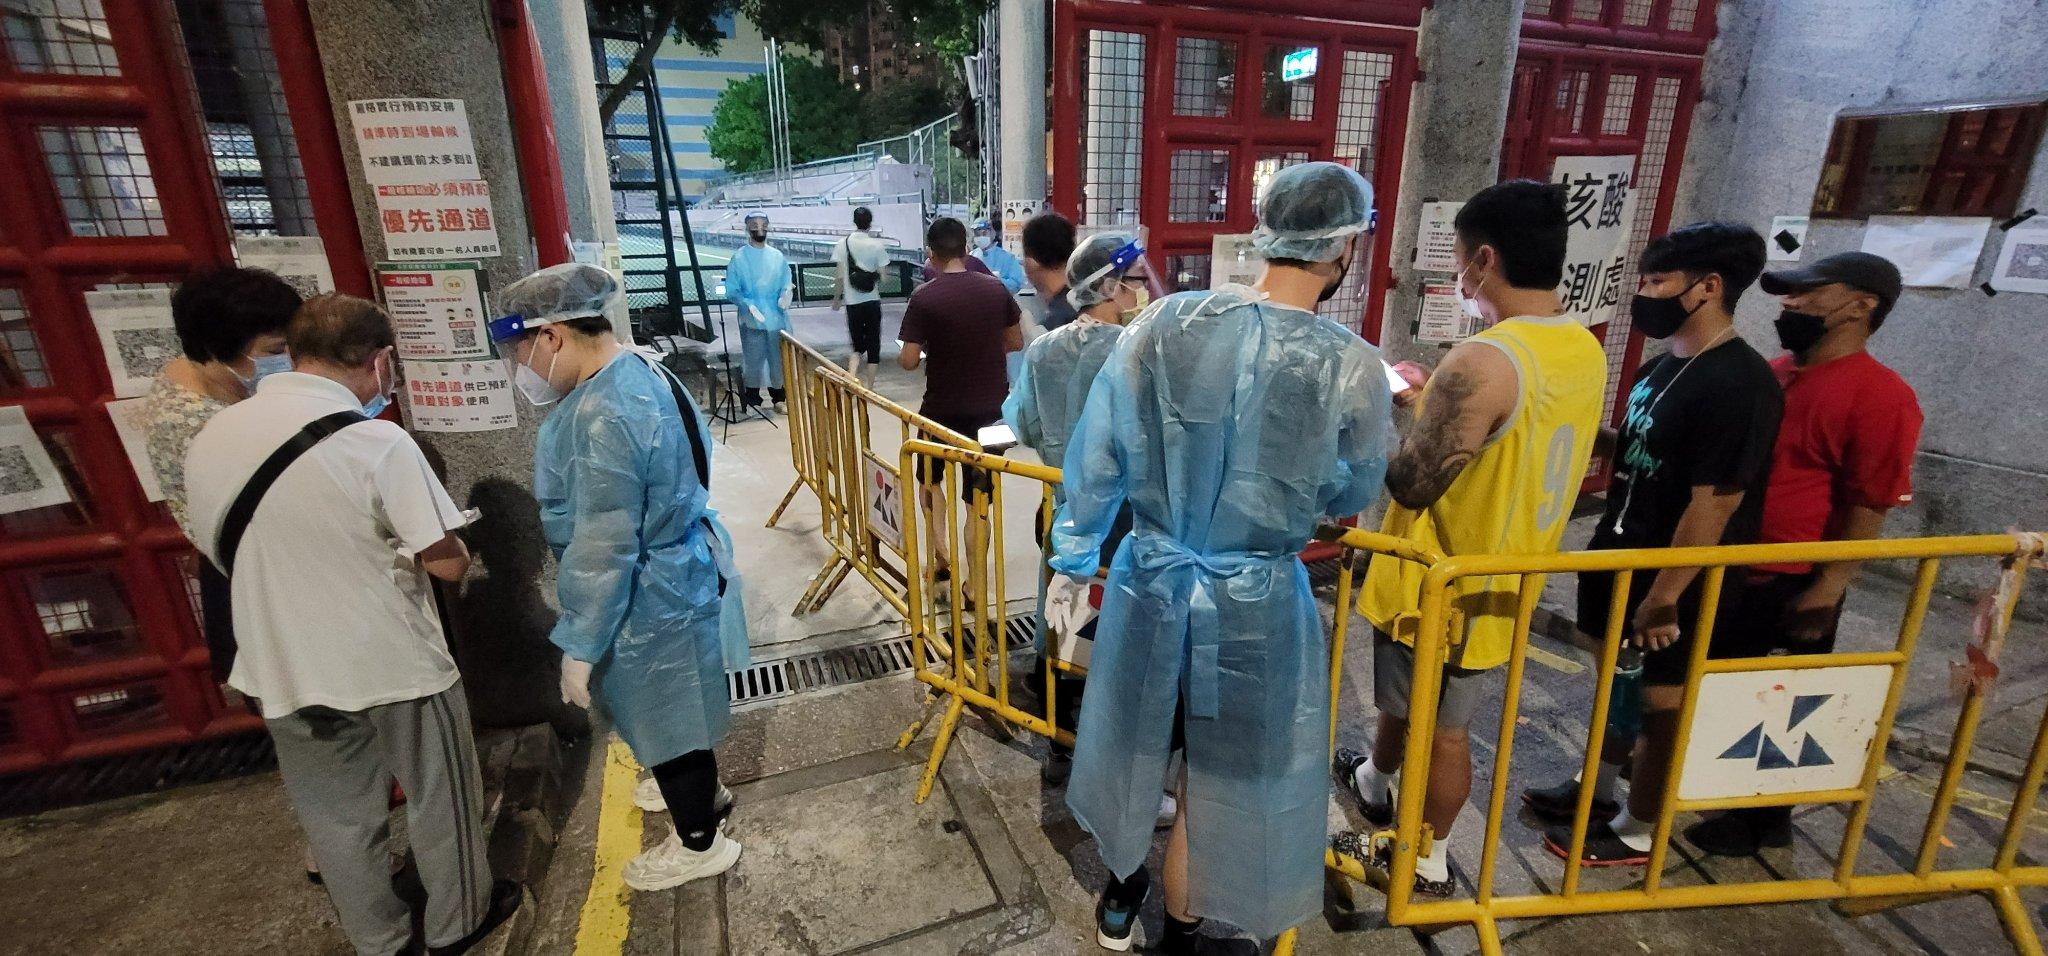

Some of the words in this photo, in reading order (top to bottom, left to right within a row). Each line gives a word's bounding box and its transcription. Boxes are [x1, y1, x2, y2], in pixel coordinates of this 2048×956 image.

[383, 207, 491, 233] 優先通道
[1560, 171, 1629, 230] 核酸
[1537, 423, 1576, 532] 9
